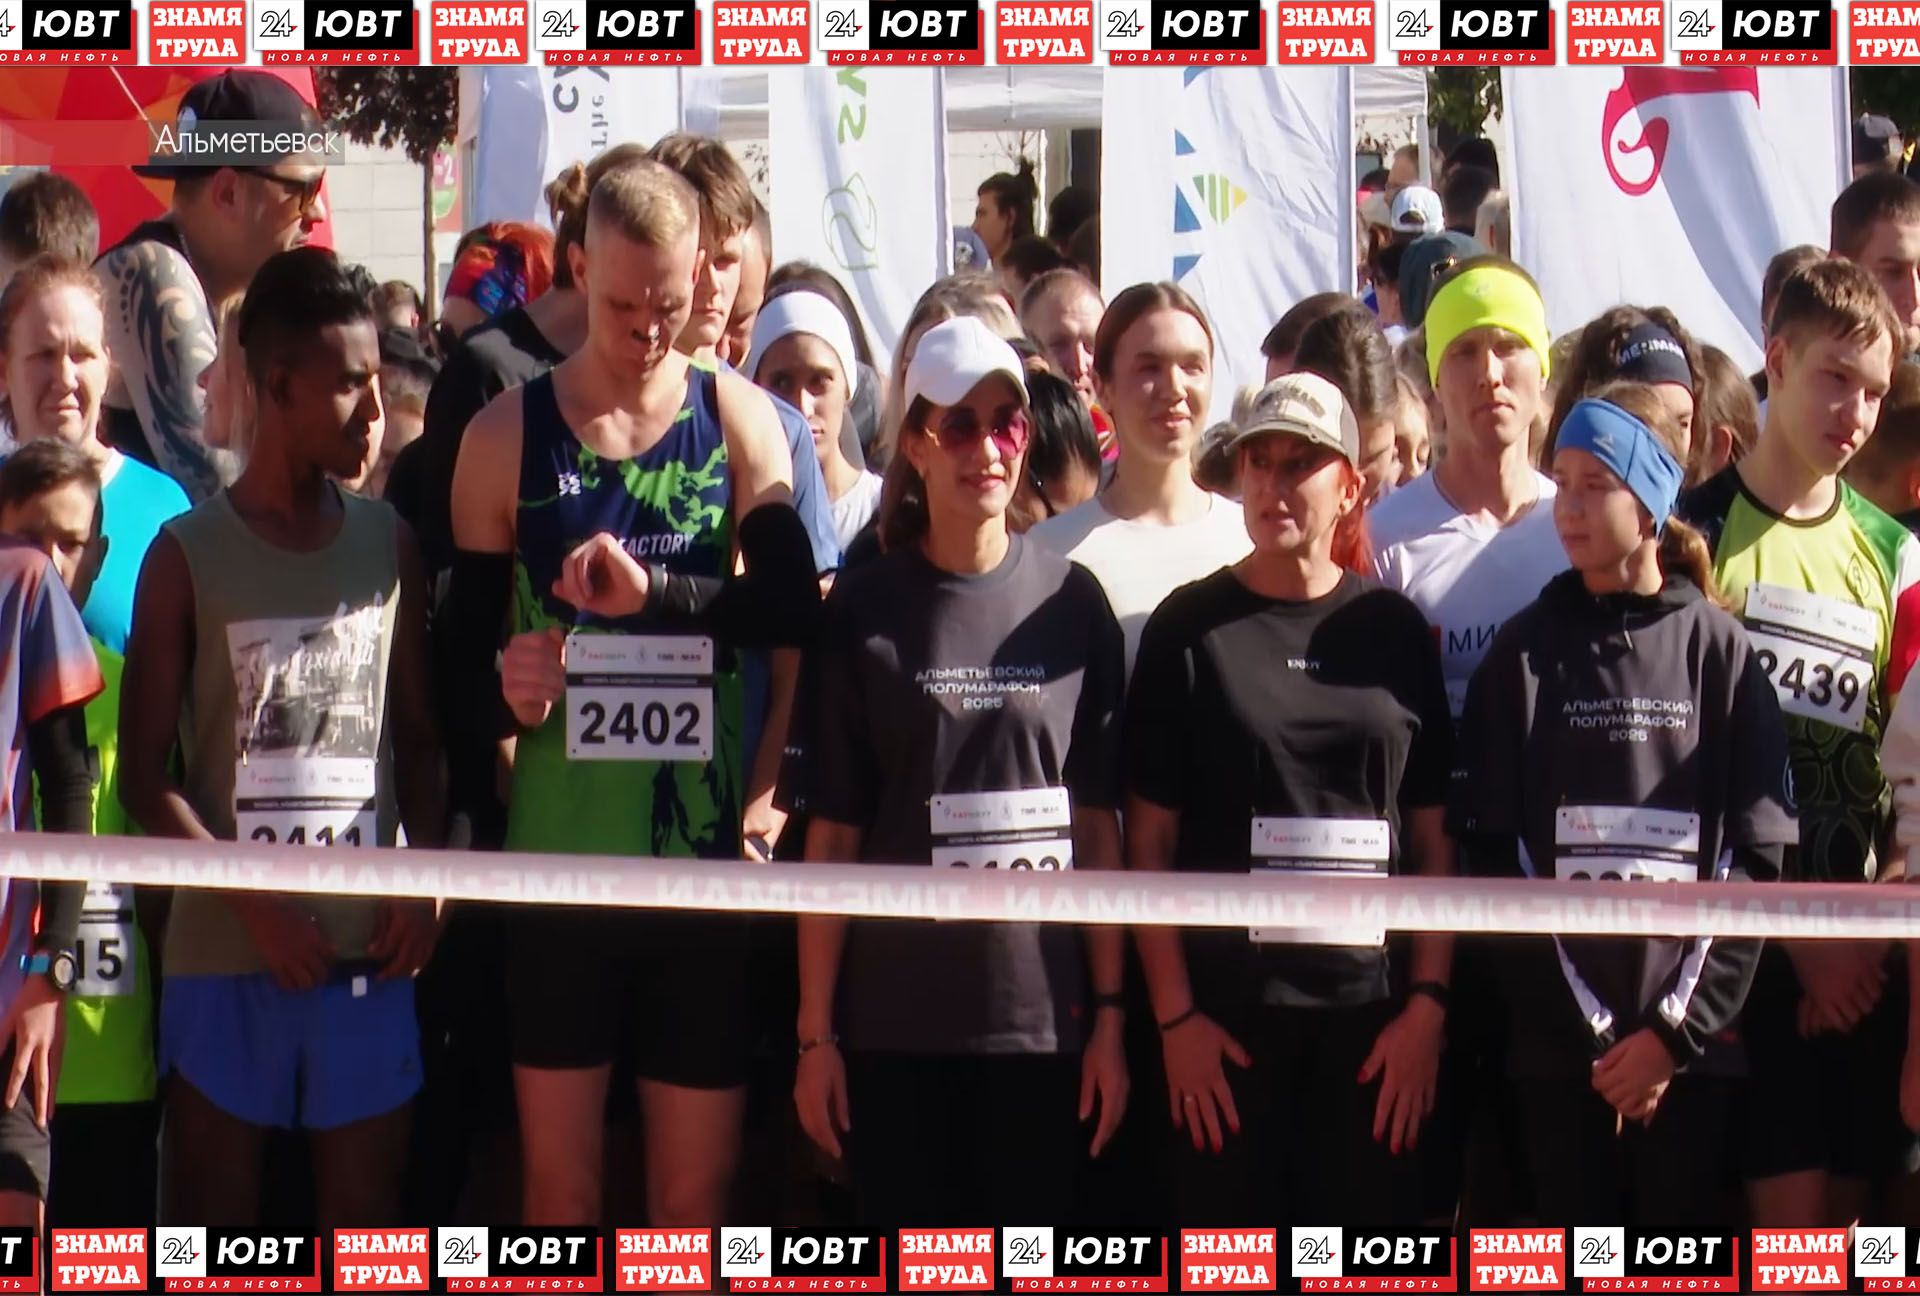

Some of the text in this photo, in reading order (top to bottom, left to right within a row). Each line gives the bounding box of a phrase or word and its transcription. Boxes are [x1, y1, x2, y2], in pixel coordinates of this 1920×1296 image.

[1449, 623, 1504, 654] МИ
[915, 664, 1046, 681] АЛЬМЕТЬЕВСКИЙ
[923, 680, 1040, 695] ПОЛУМАРАФОН
[1562, 697, 1694, 714] АЛЬМЕТЬЕВСКИЙ
[579, 701, 700, 746] 2402
[1569, 713, 1687, 729] ПОЛУМАРАФОН
[75, 937, 123, 982] 15
